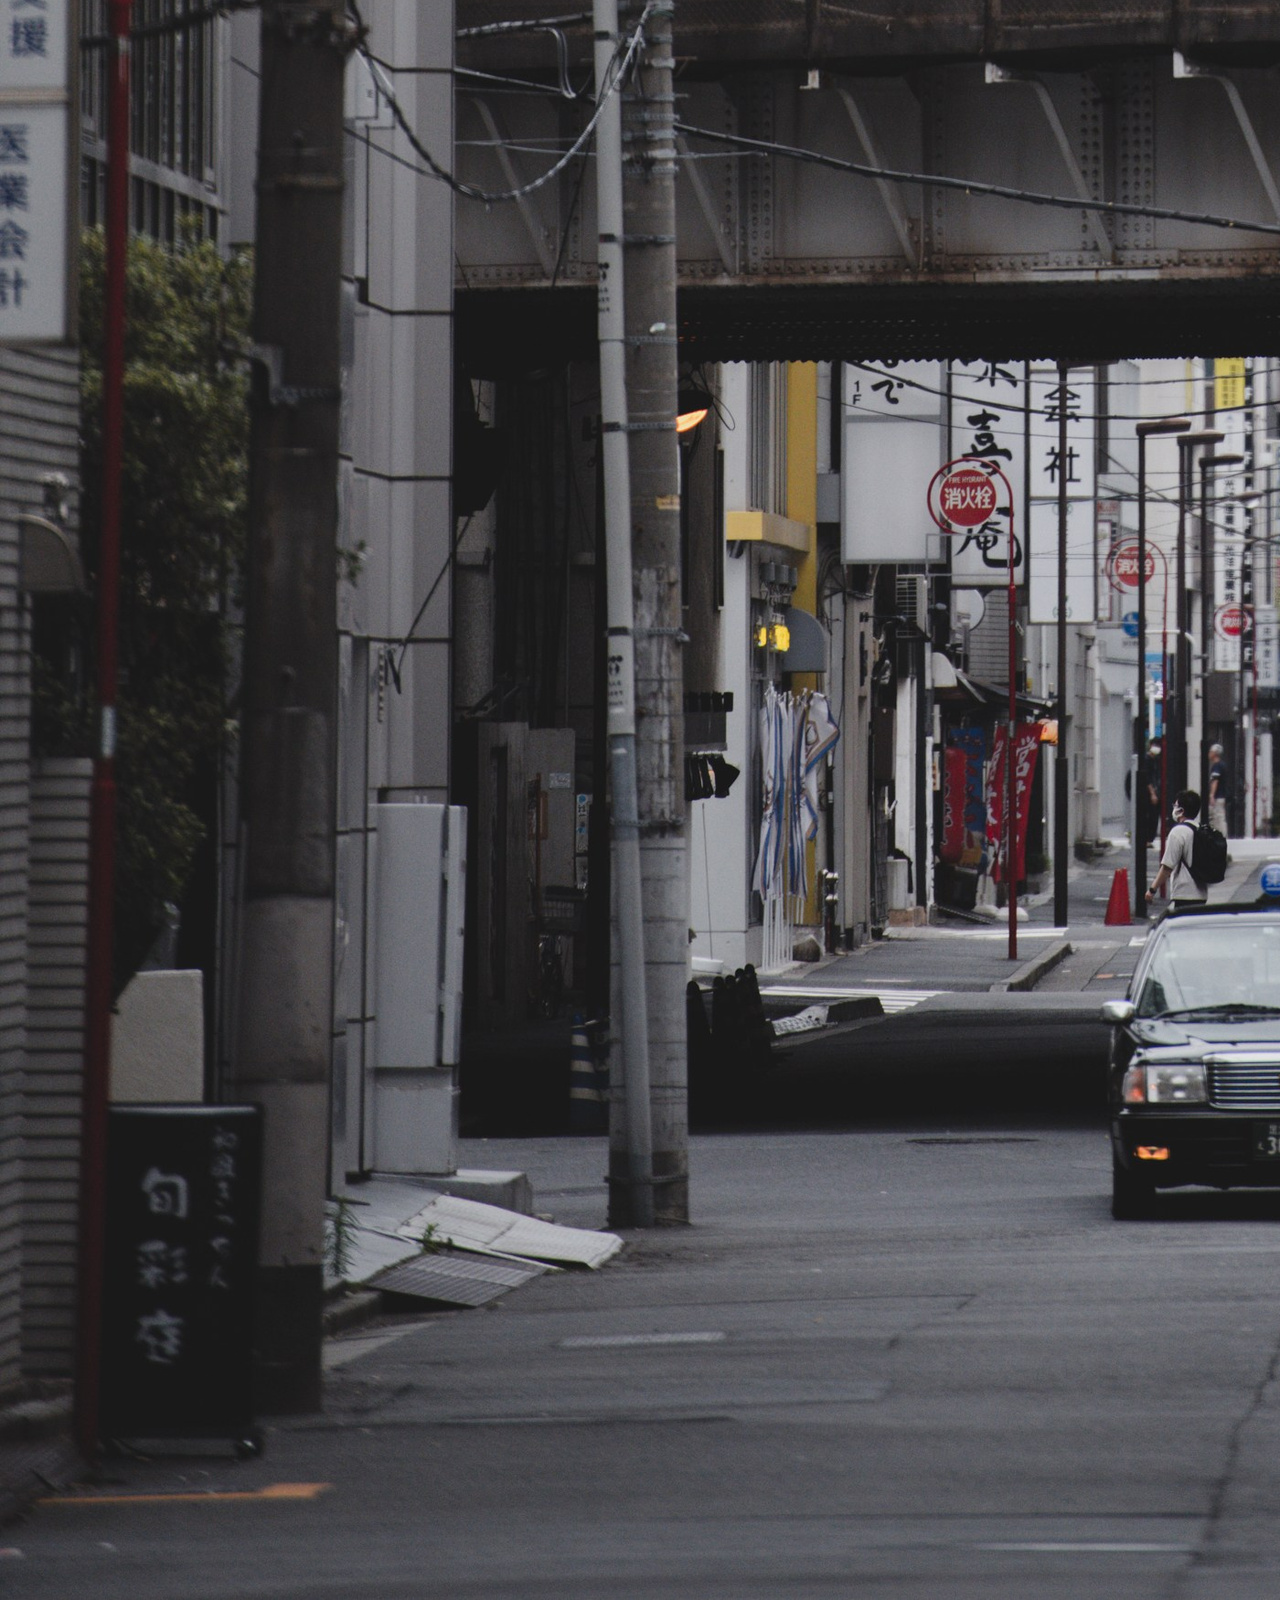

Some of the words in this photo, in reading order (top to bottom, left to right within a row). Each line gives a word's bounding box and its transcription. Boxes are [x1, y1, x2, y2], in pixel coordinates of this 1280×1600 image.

[948, 474, 960, 484] FIRE
[944, 486, 994, 511] 消火栓
[1117, 558, 1153, 576] 消火栓
